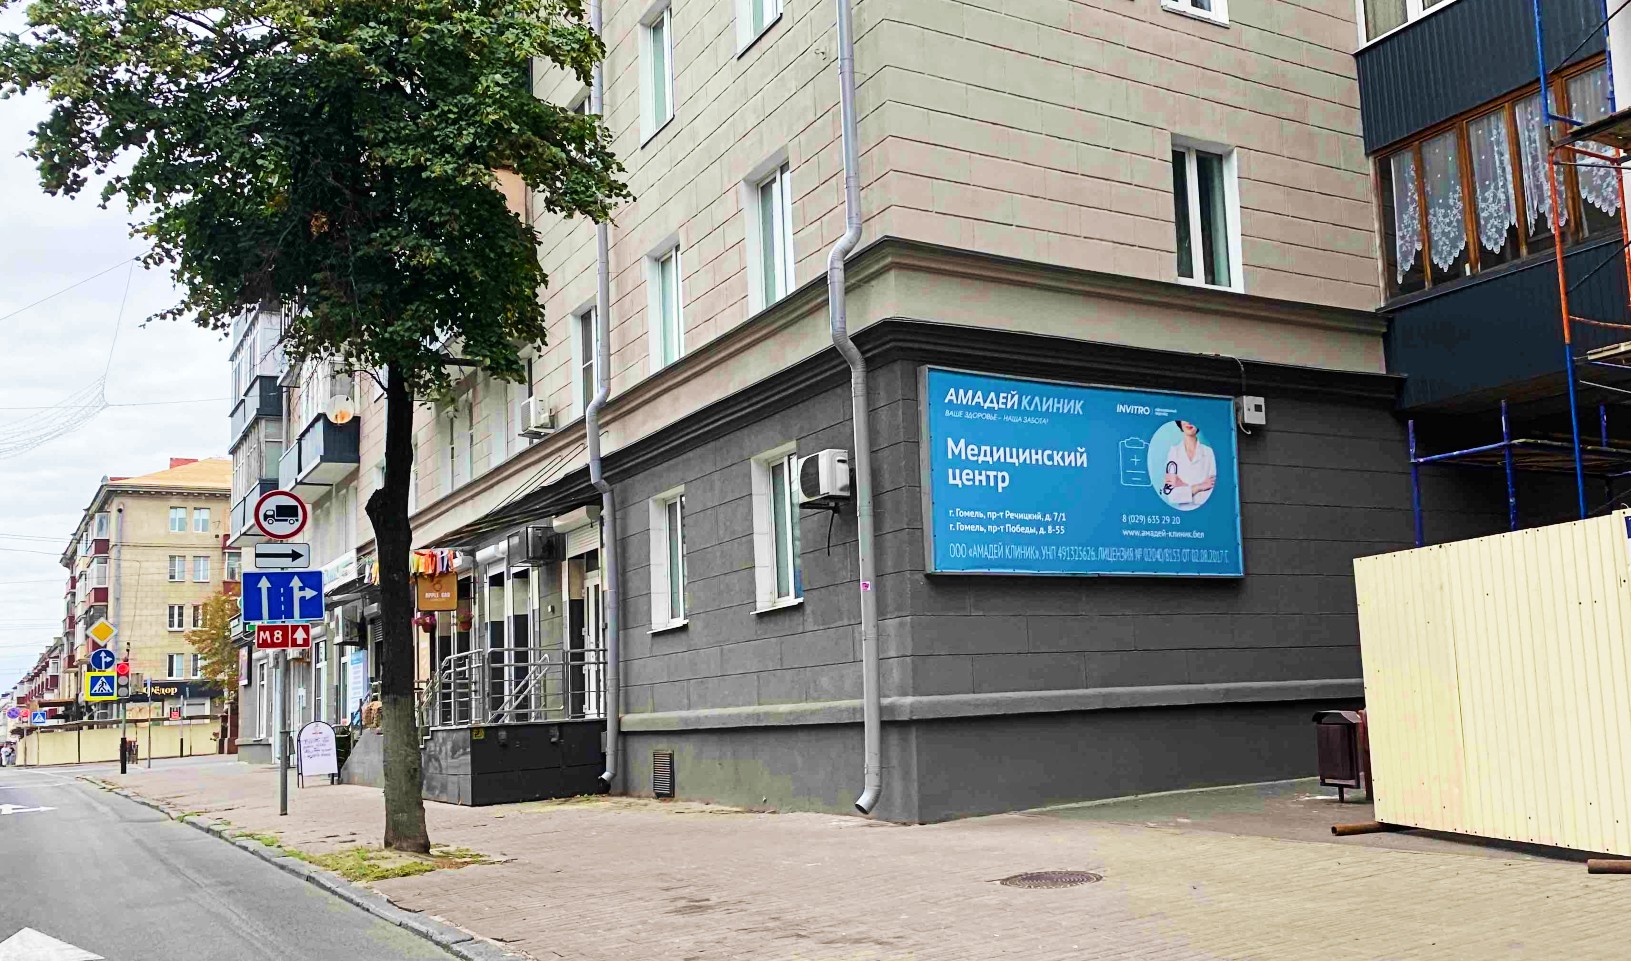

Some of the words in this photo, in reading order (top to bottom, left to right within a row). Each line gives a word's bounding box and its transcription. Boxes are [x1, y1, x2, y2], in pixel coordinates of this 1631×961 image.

[944, 387, 1019, 410] АМАДЕЙ
[1021, 395, 1085, 414] КЛИНИК
[944, 409, 963, 418] ВАШЕ
[964, 411, 998, 421] ЗДОРОВЬЕ
[1003, 414, 1023, 423] НАША
[1116, 403, 1150, 415] INVITRO
[947, 437, 1088, 468] Медицинский
[948, 468, 1010, 492] центр
[949, 509, 955, 517] г.
[956, 508, 986, 519] Гомель,
[987, 510, 1004, 520] пр-т
[1005, 510, 1044, 522] Речицкий,
[1045, 513, 1052, 522] д.
[1053, 512, 1067, 522] 7/1
[1122, 514, 1127, 523] 8
[1128, 514, 1146, 525] (029)
[1147, 515, 1160, 524] 635
[1161, 516, 1171, 524] 29
[1171, 516, 1181, 525] 20
[949, 523, 955, 531] г.
[956, 522, 987, 533] Гомель,
[988, 524, 1004, 534] пр-т
[1005, 523, 1038, 535] Победы,
[1039, 527, 1047, 535] д.
[1047, 526, 1065, 535] 8-55
[949, 543, 967, 558] ООО
[968, 542, 1003, 560] «АМАДЕЙ
